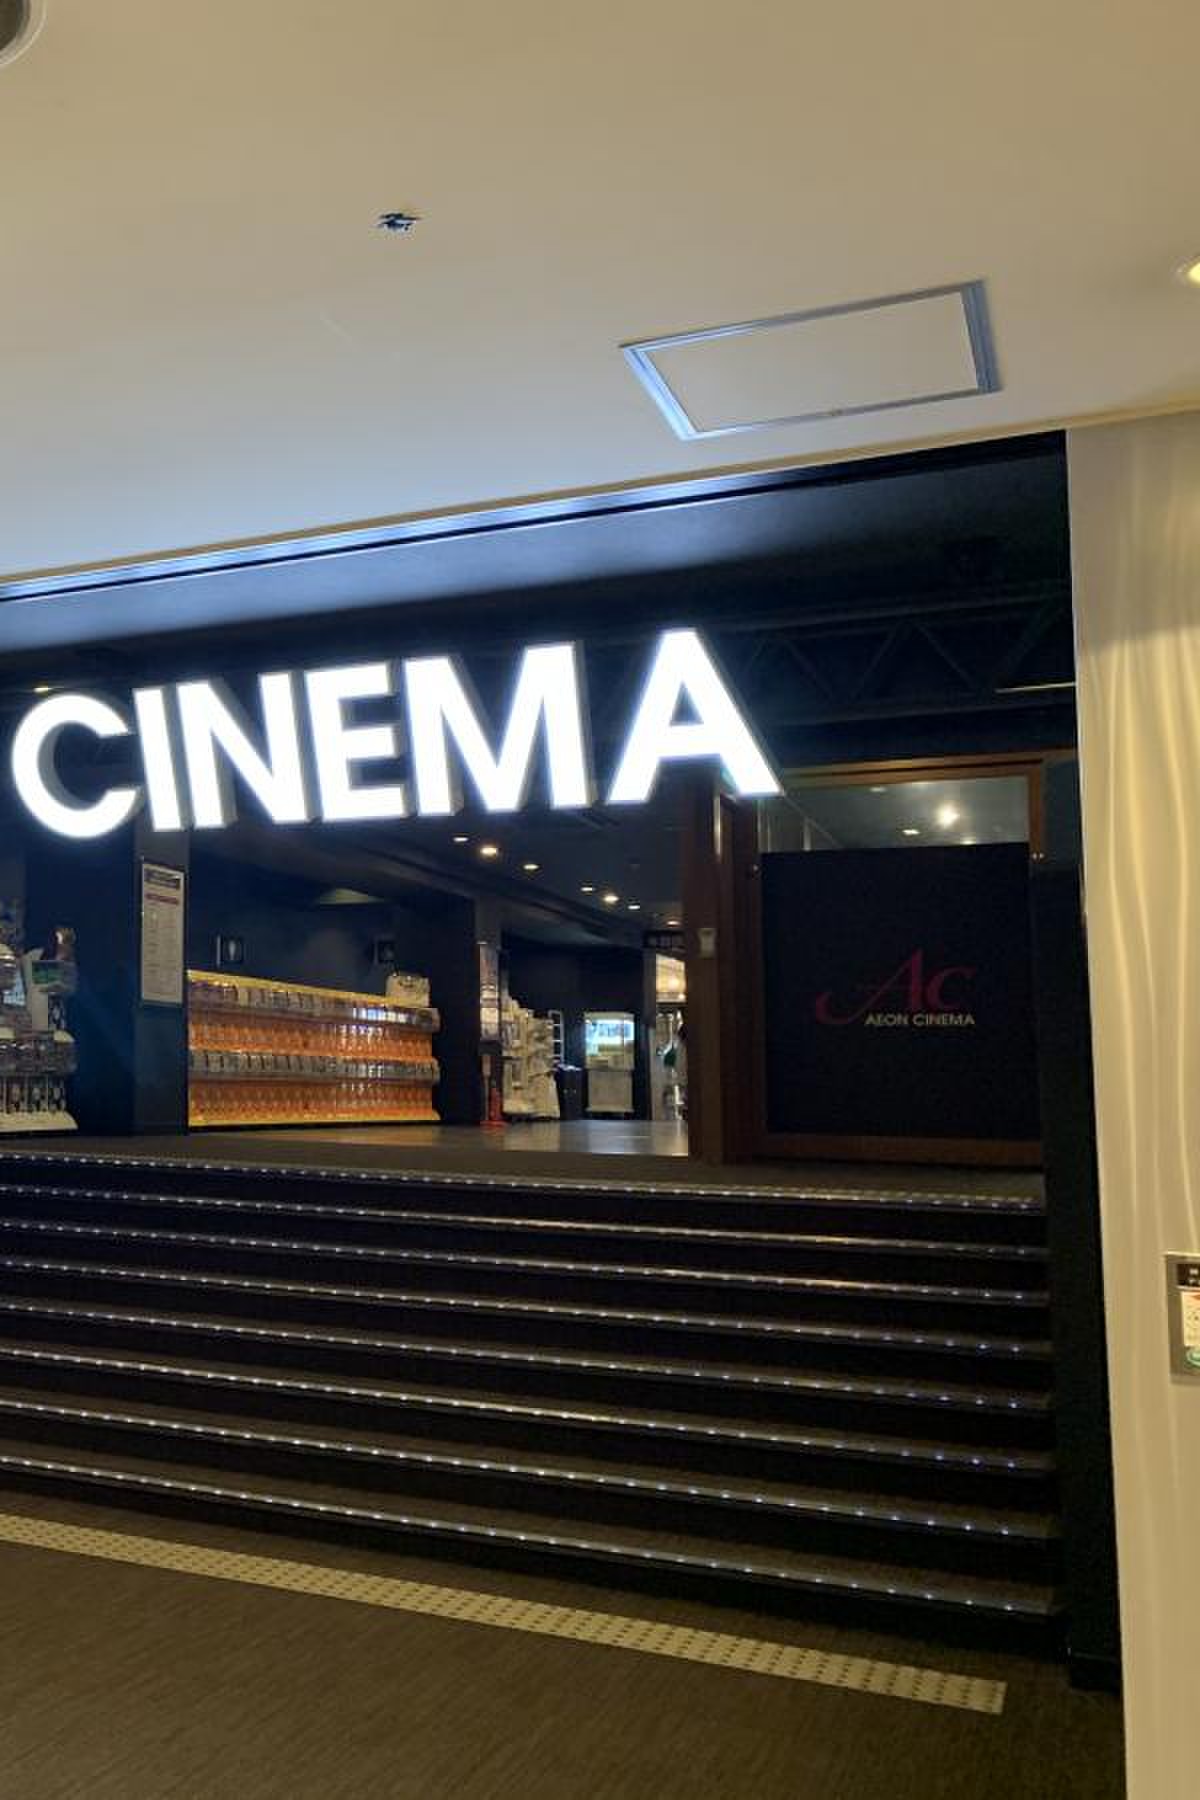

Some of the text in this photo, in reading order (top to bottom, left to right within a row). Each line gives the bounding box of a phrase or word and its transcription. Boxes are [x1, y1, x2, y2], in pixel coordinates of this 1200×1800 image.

[11, 627, 784, 838] CINEMA
[865, 1012, 976, 1027] AEON CINEMA
